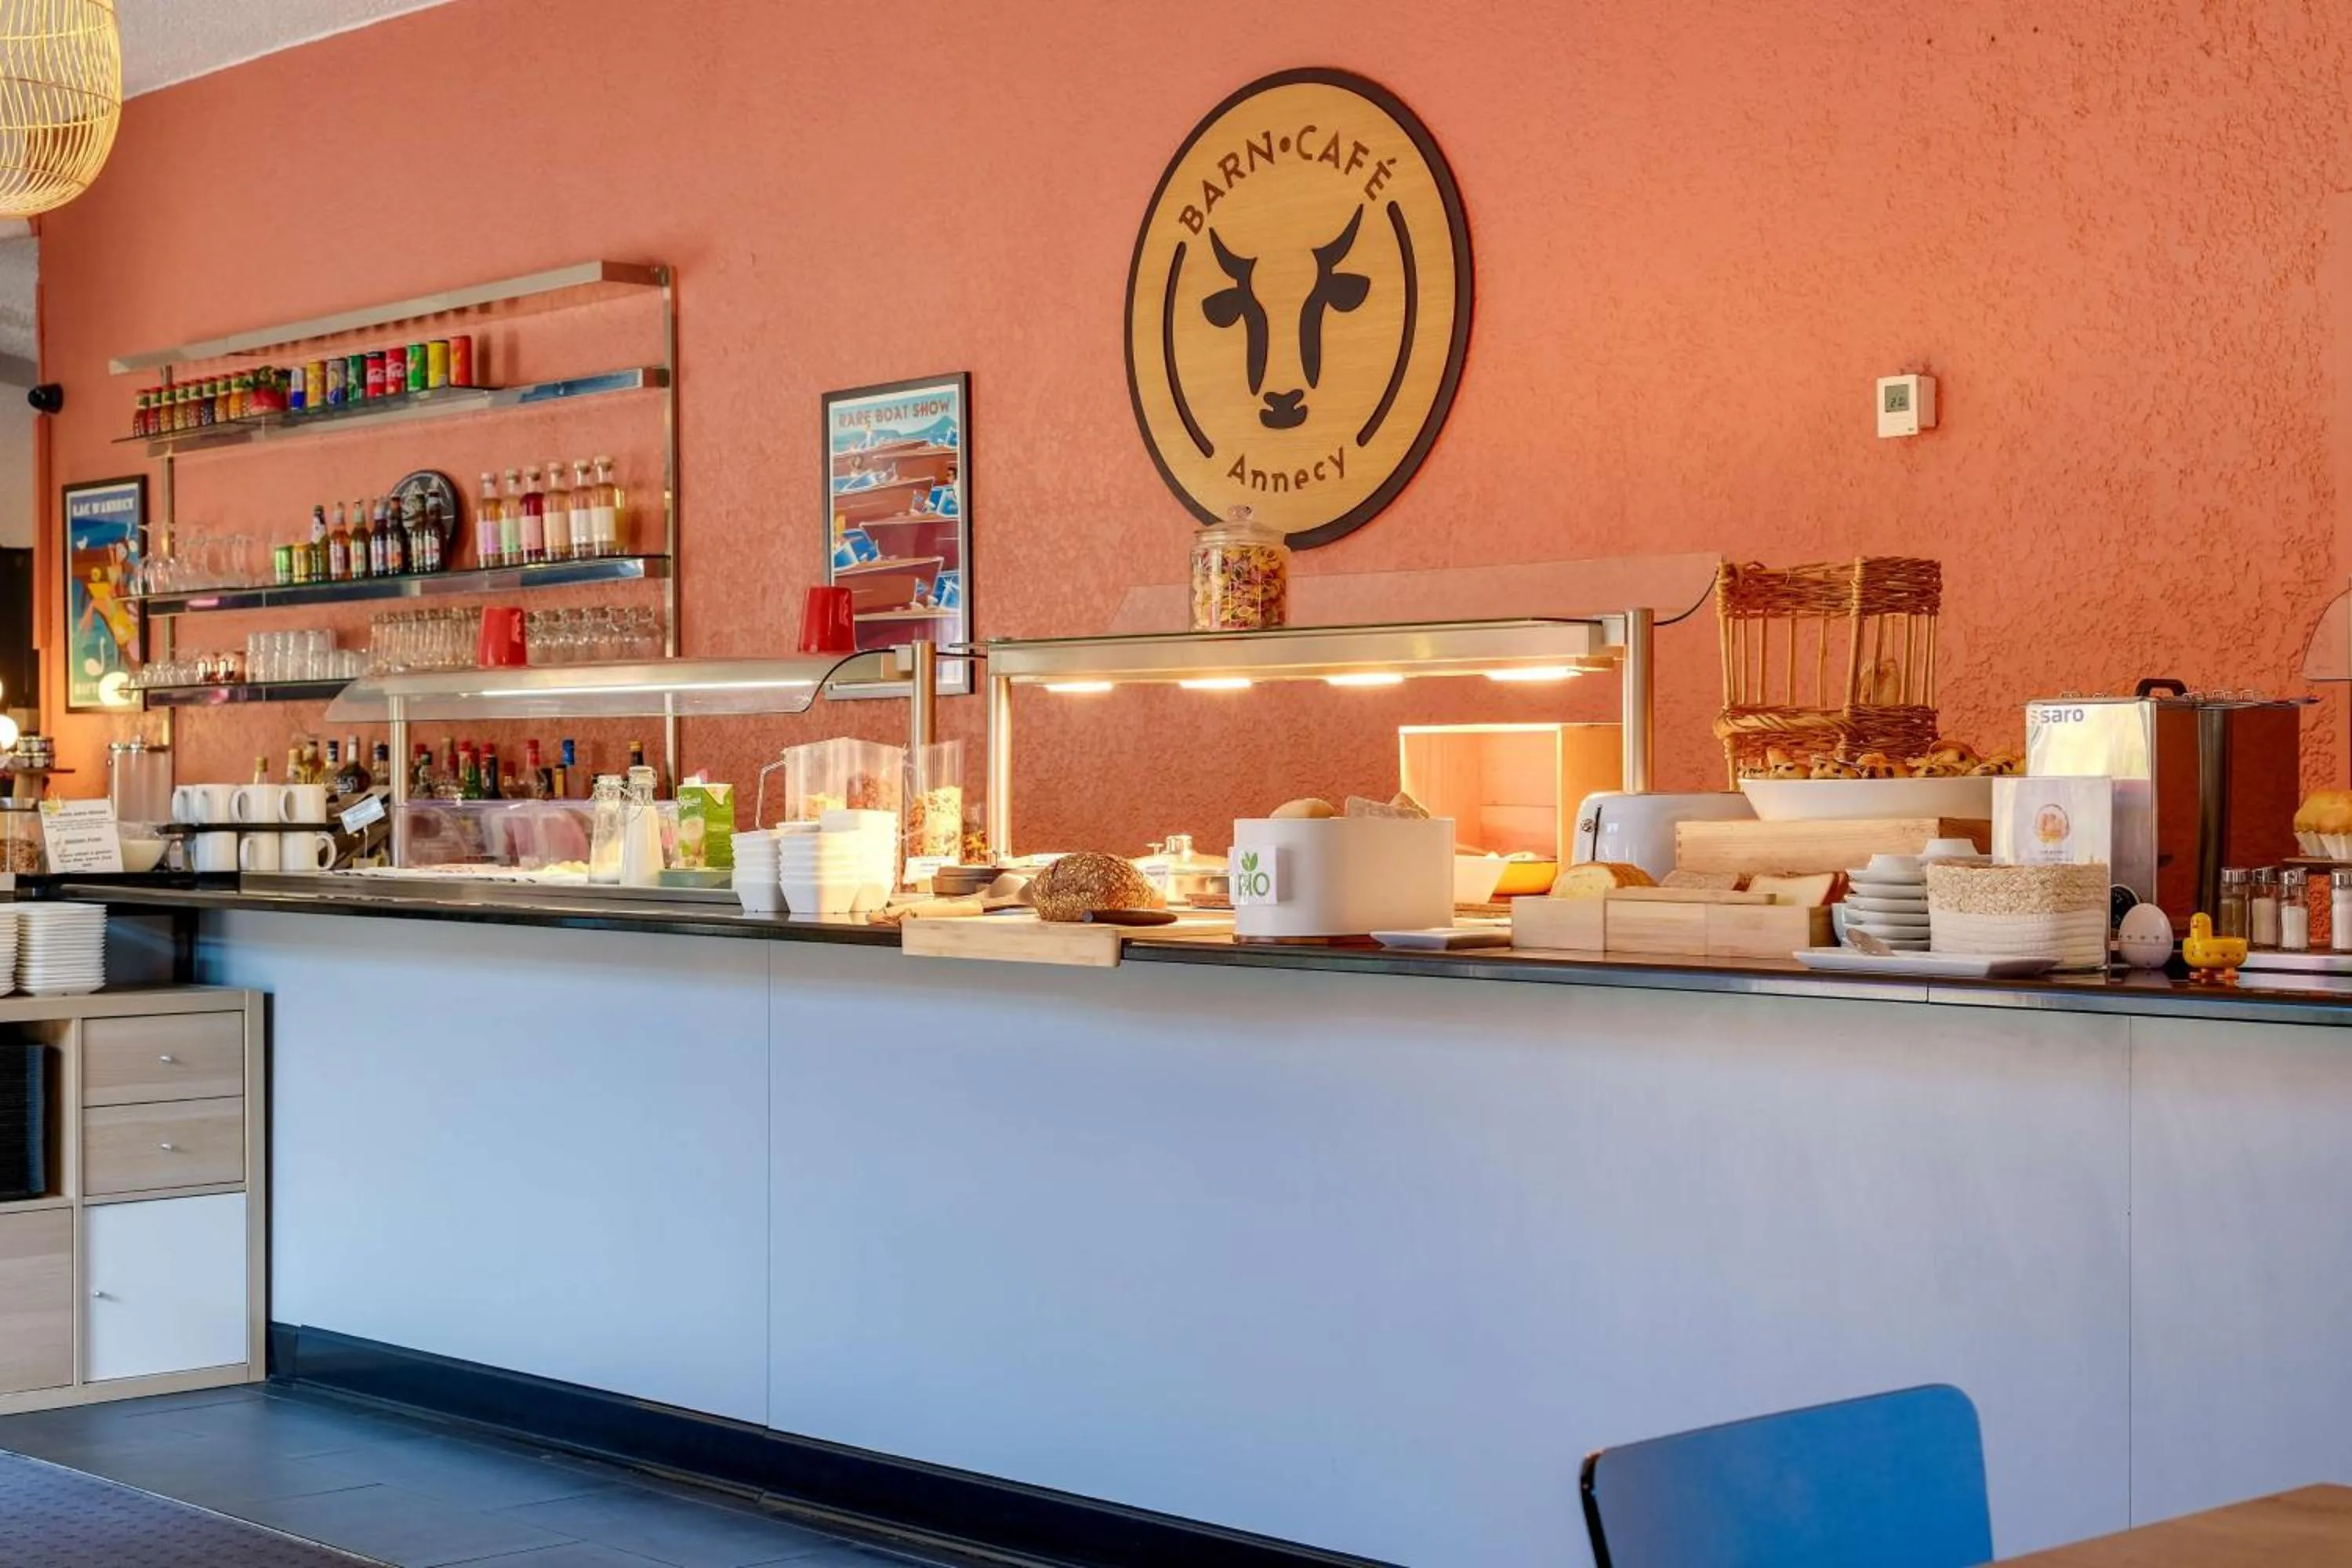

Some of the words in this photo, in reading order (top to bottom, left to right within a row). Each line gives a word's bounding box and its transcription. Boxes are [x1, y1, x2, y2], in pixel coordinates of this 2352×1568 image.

[1178, 130, 1273, 236] BARN
[1295, 124, 1398, 202] CAFÉ
[838, 410, 872, 427] RARE
[875, 405, 909, 423] BOAT
[912, 399, 950, 418] SHOW
[1225, 446, 1345, 495] Annecy
[2040, 708, 2085, 724] saro
